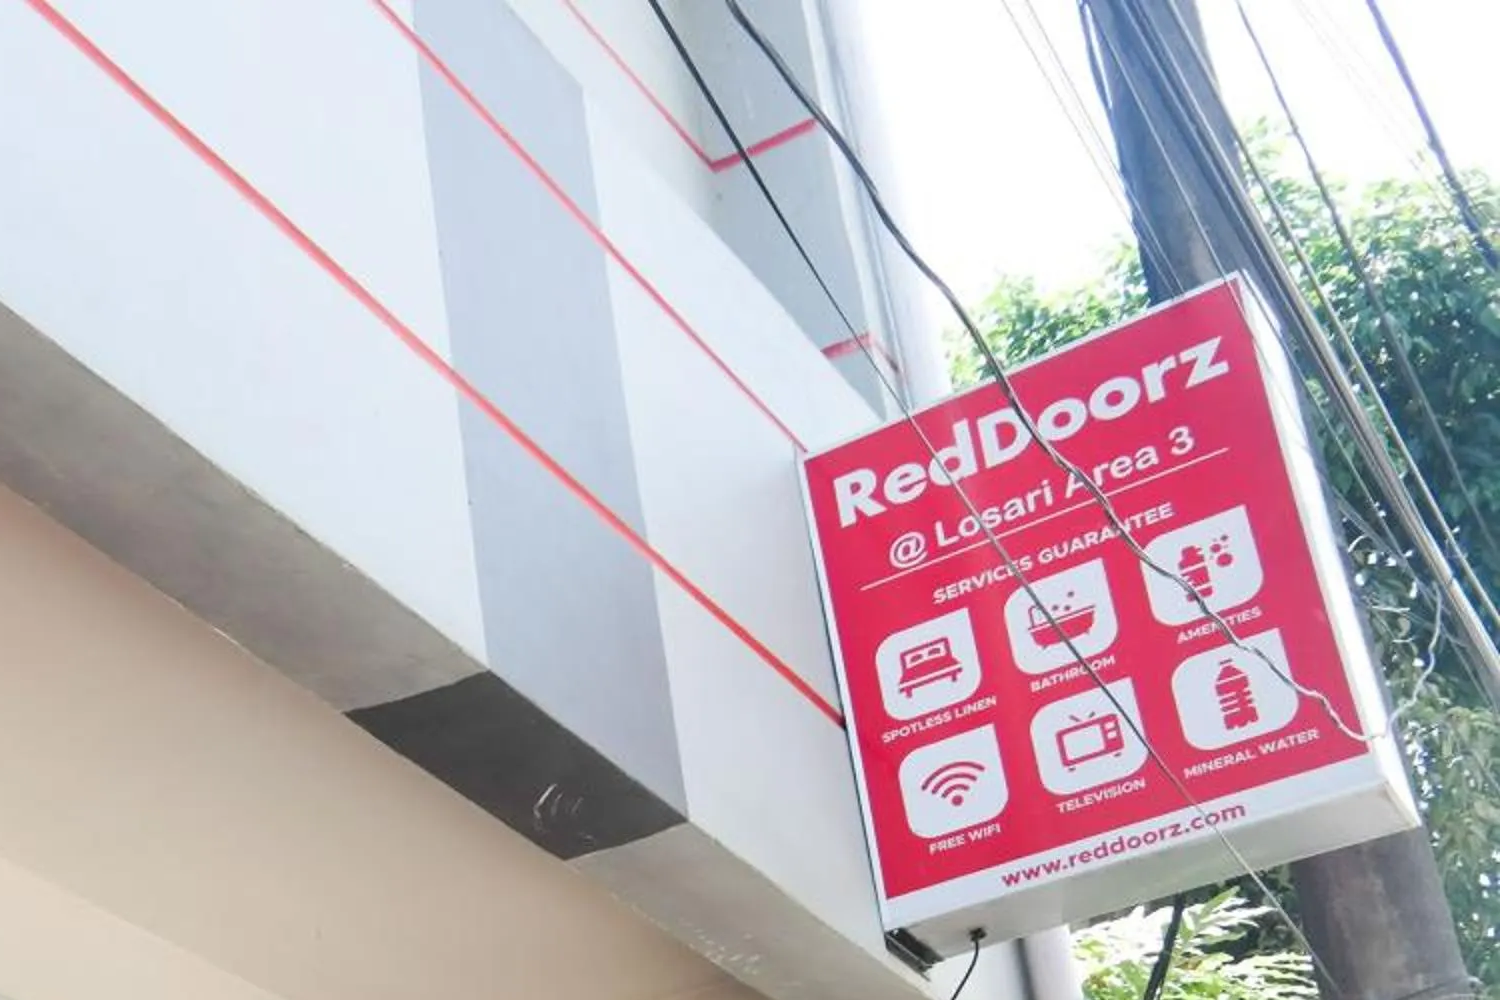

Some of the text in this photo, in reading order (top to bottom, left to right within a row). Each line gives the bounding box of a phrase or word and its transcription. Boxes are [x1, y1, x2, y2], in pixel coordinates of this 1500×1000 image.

[833, 336, 1229, 528] RedDoorz
[935, 480, 1053, 547] Losari
[1065, 445, 1158, 498] Area
[1168, 425, 1194, 456] 3
[932, 557, 1033, 604] SERVICES
[1177, 606, 1262, 644] AMENTIES
[1030, 656, 1116, 693] BATHROOM
[882, 695, 997, 743] SPOTLESS LINEN
[1183, 728, 1319, 779] MINERAL WATER
[1056, 777, 1146, 813] TELEVISION
[929, 824, 1001, 855] FREE WIFI
[1002, 802, 1246, 887] www.reddoorz.com
